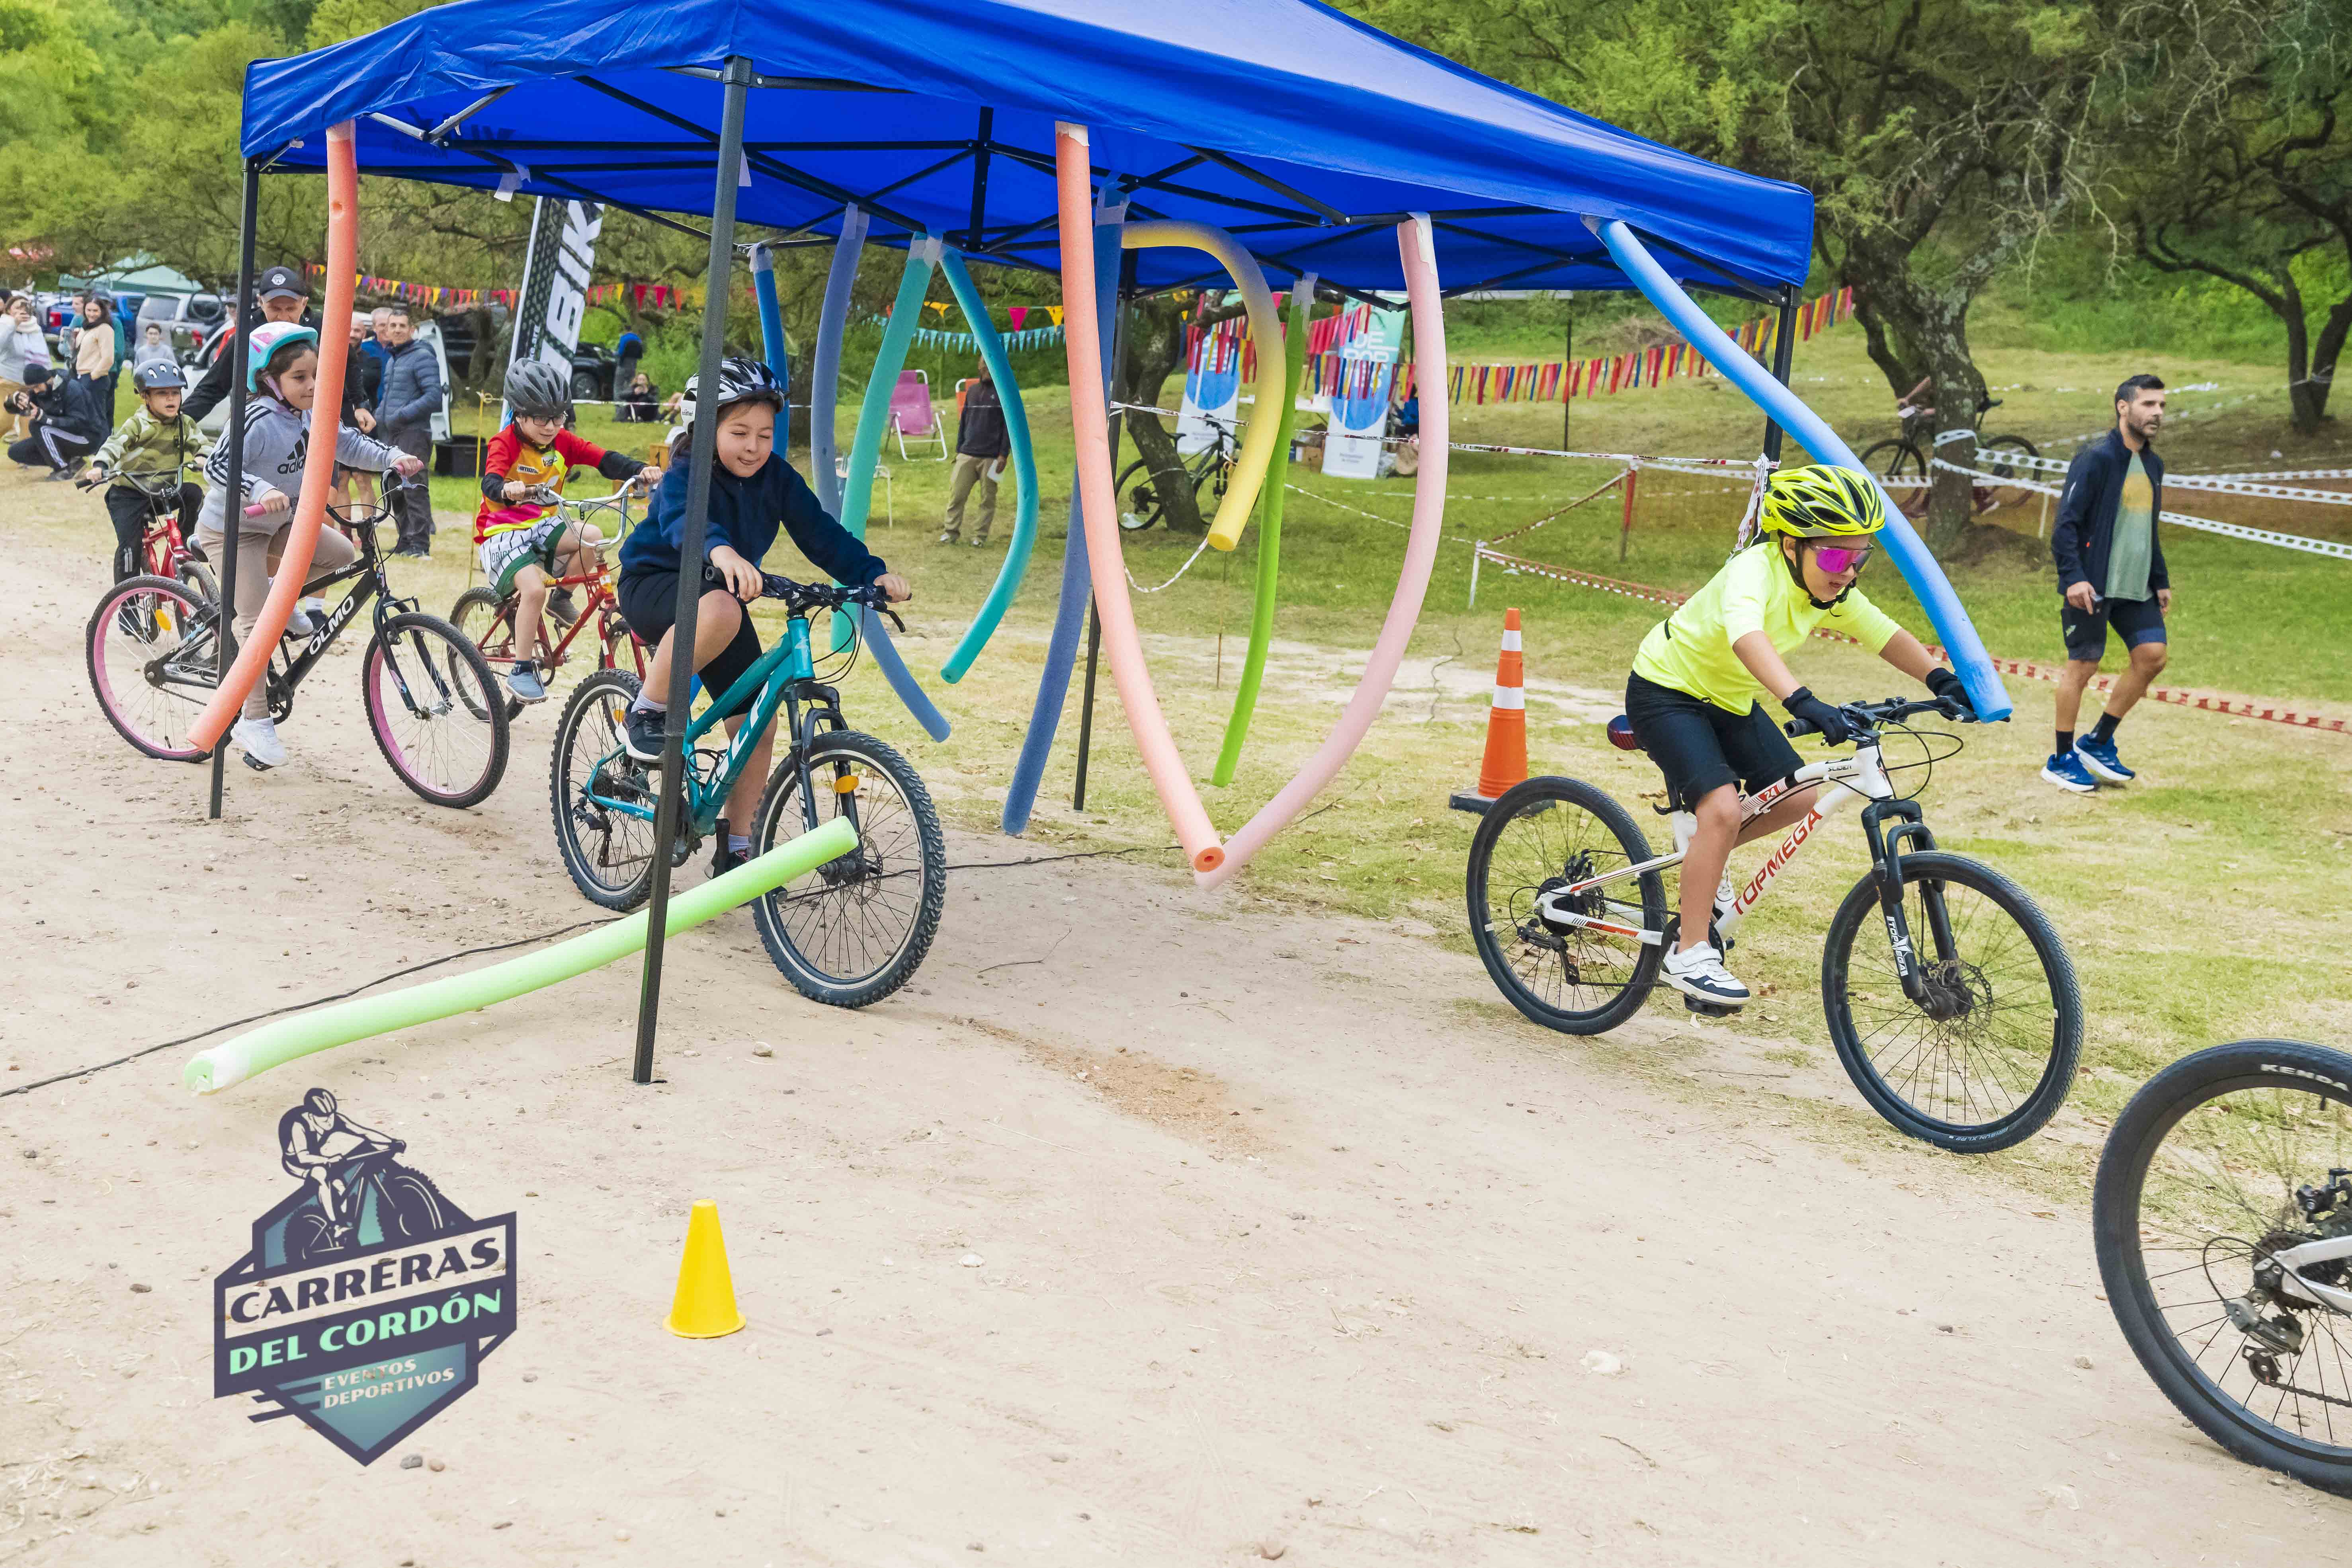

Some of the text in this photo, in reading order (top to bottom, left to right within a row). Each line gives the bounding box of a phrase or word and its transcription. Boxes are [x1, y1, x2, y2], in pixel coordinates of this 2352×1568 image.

[539, 199, 606, 383] BIK
[309, 596, 354, 655] OLMO
[1764, 787, 1778, 801] 24
[1732, 808, 1823, 915] TOPMEGA
[2260, 1064, 2350, 1093] KENDA
